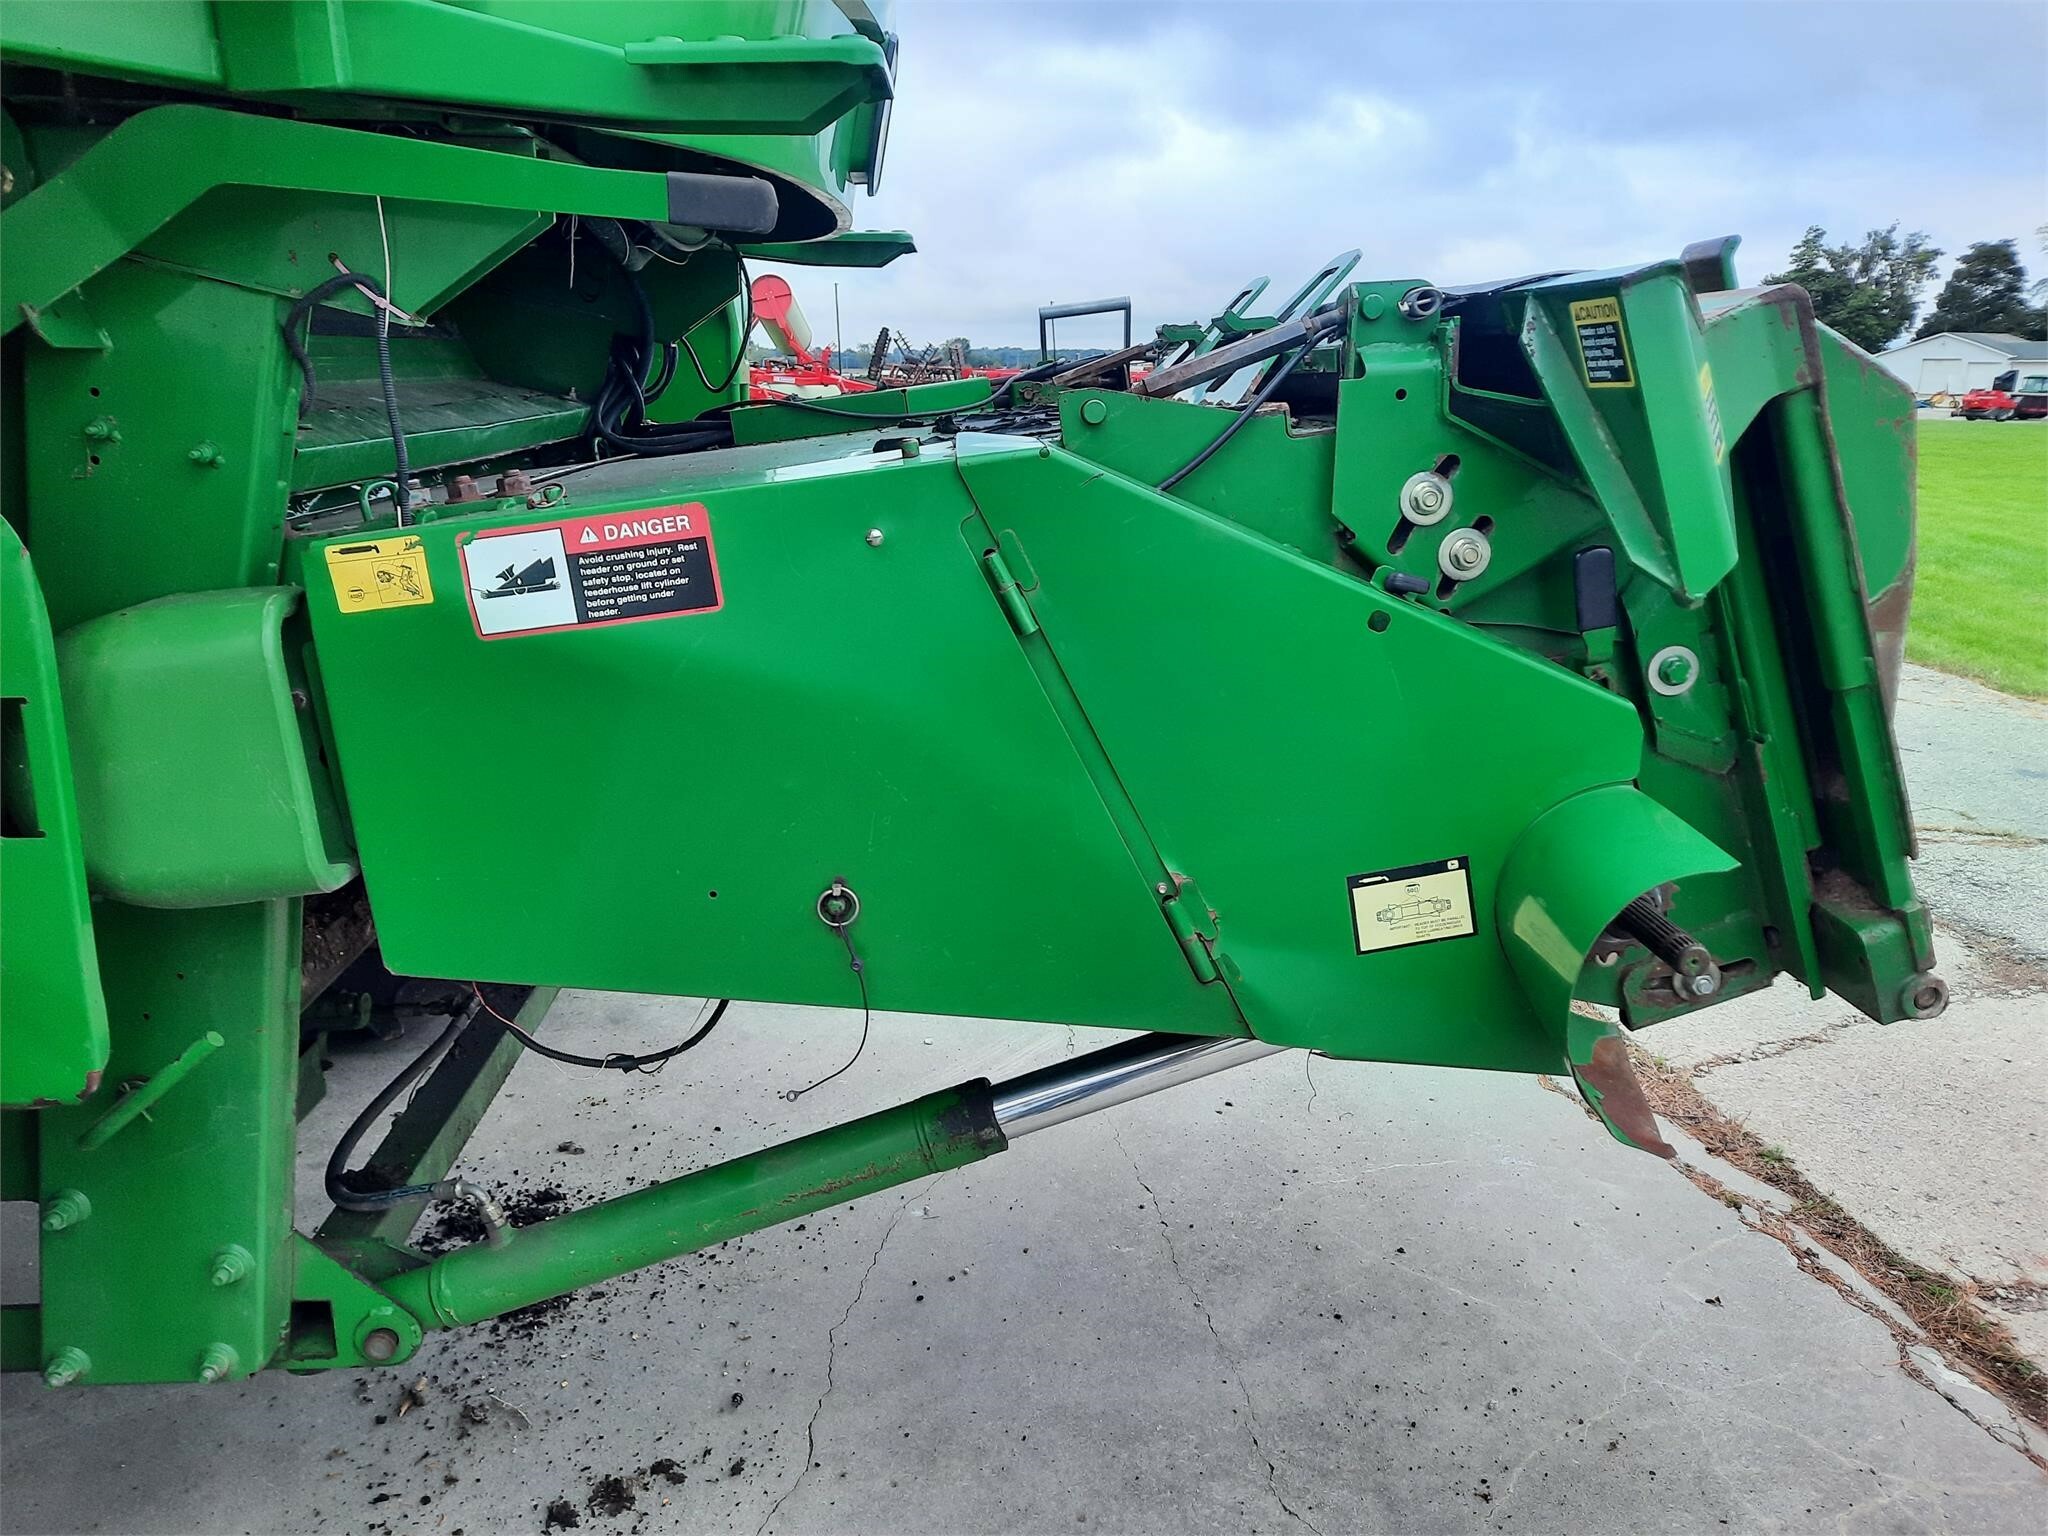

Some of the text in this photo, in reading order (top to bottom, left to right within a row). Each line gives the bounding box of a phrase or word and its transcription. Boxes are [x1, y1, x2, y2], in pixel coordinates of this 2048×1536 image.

[1580, 303, 1617, 320] CAUTION
[604, 515, 690, 540] DANGER
[579, 542, 698, 565] Avoid crushing injury. Rest
[580, 566, 610, 576] header
[626, 559, 658, 571] ground
[583, 576, 609, 587] safety
[612, 574, 634, 583] stop,
[636, 569, 667, 580] located
[584, 577, 689, 597] feederhouse lift cylinder
[586, 590, 674, 608] before getting under
[588, 608, 621, 618] header.
